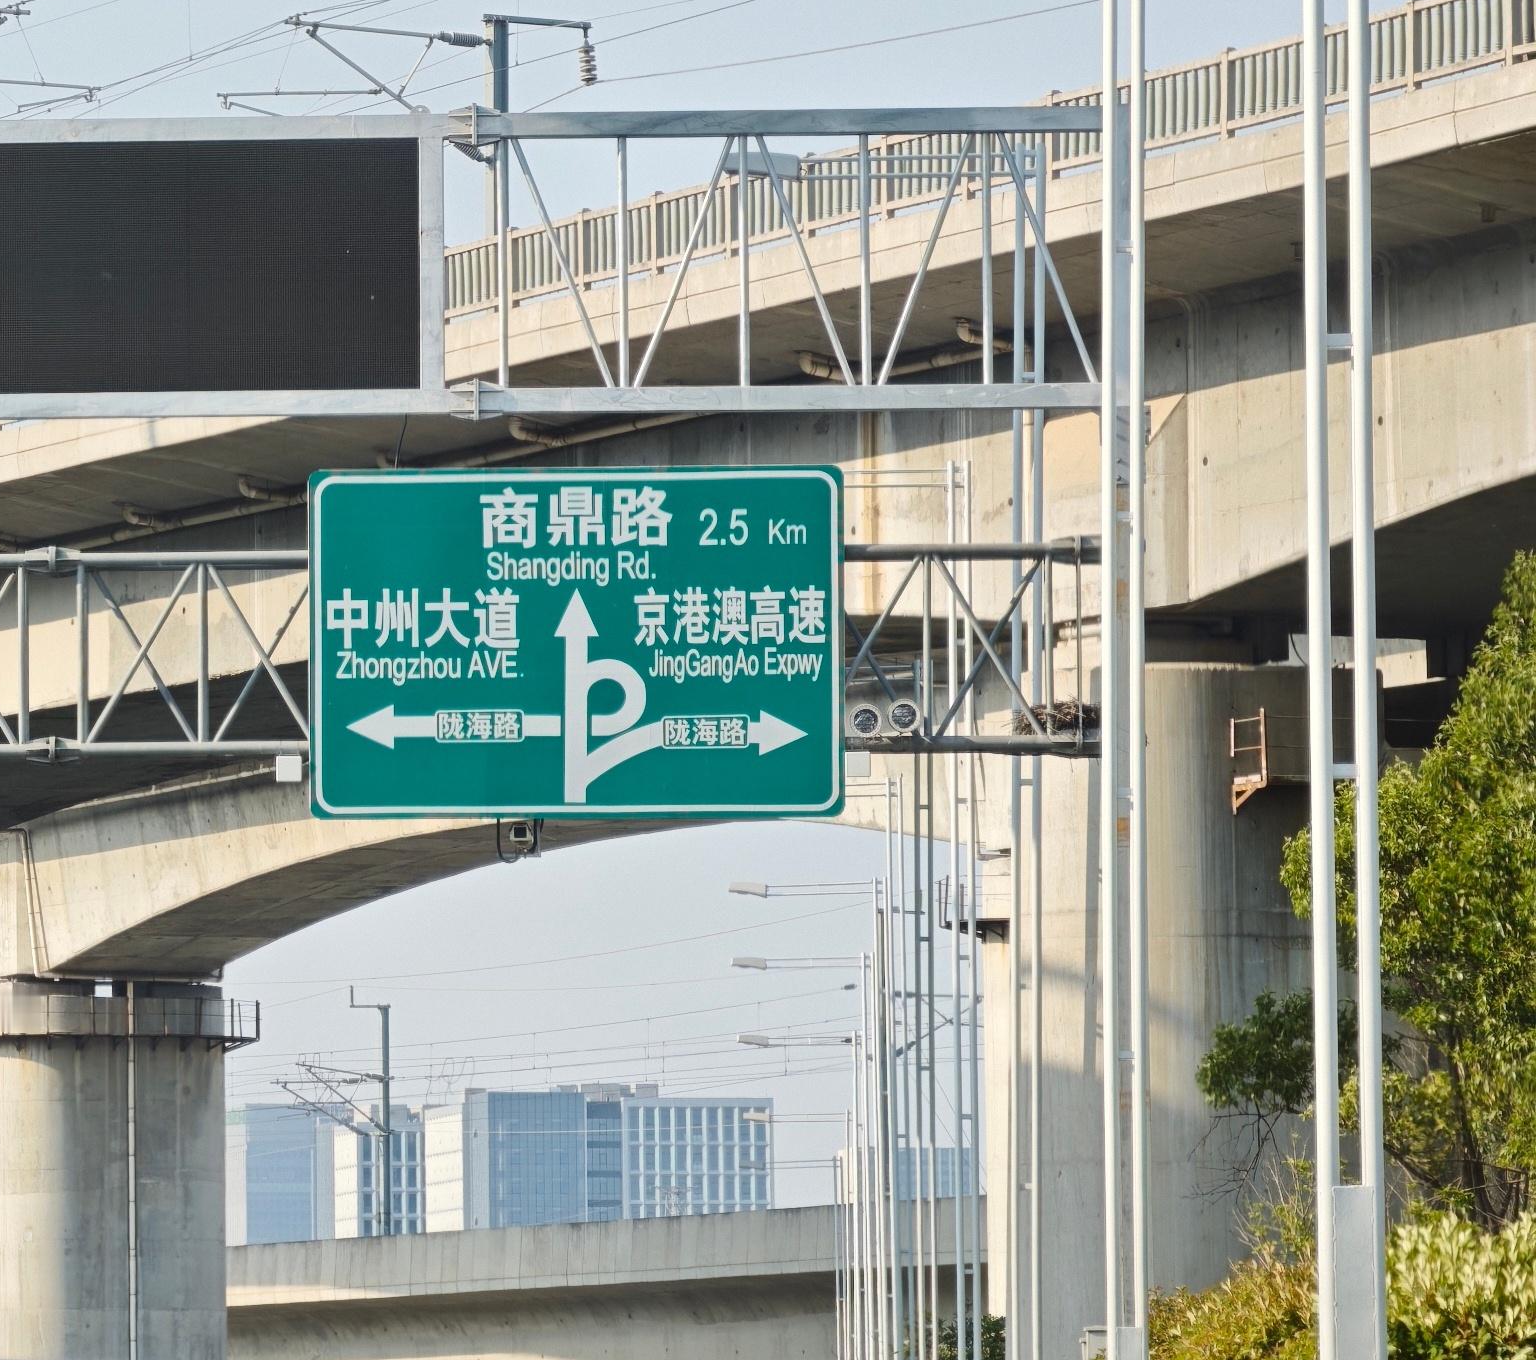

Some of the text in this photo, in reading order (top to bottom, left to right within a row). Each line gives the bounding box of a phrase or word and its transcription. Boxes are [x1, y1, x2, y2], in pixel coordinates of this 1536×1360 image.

[480, 486, 806, 548] 商鼎路 2.5 Km
[487, 551, 656, 586] Shangding Rd.
[327, 588, 519, 649] 中州大道
[634, 585, 825, 646] 京港澳高速
[336, 651, 461, 686] Zhongzhou
[649, 650, 822, 683] JingGangAo Expwy
[438, 713, 520, 739] 陇海路
[664, 720, 746, 745] 陇海路
